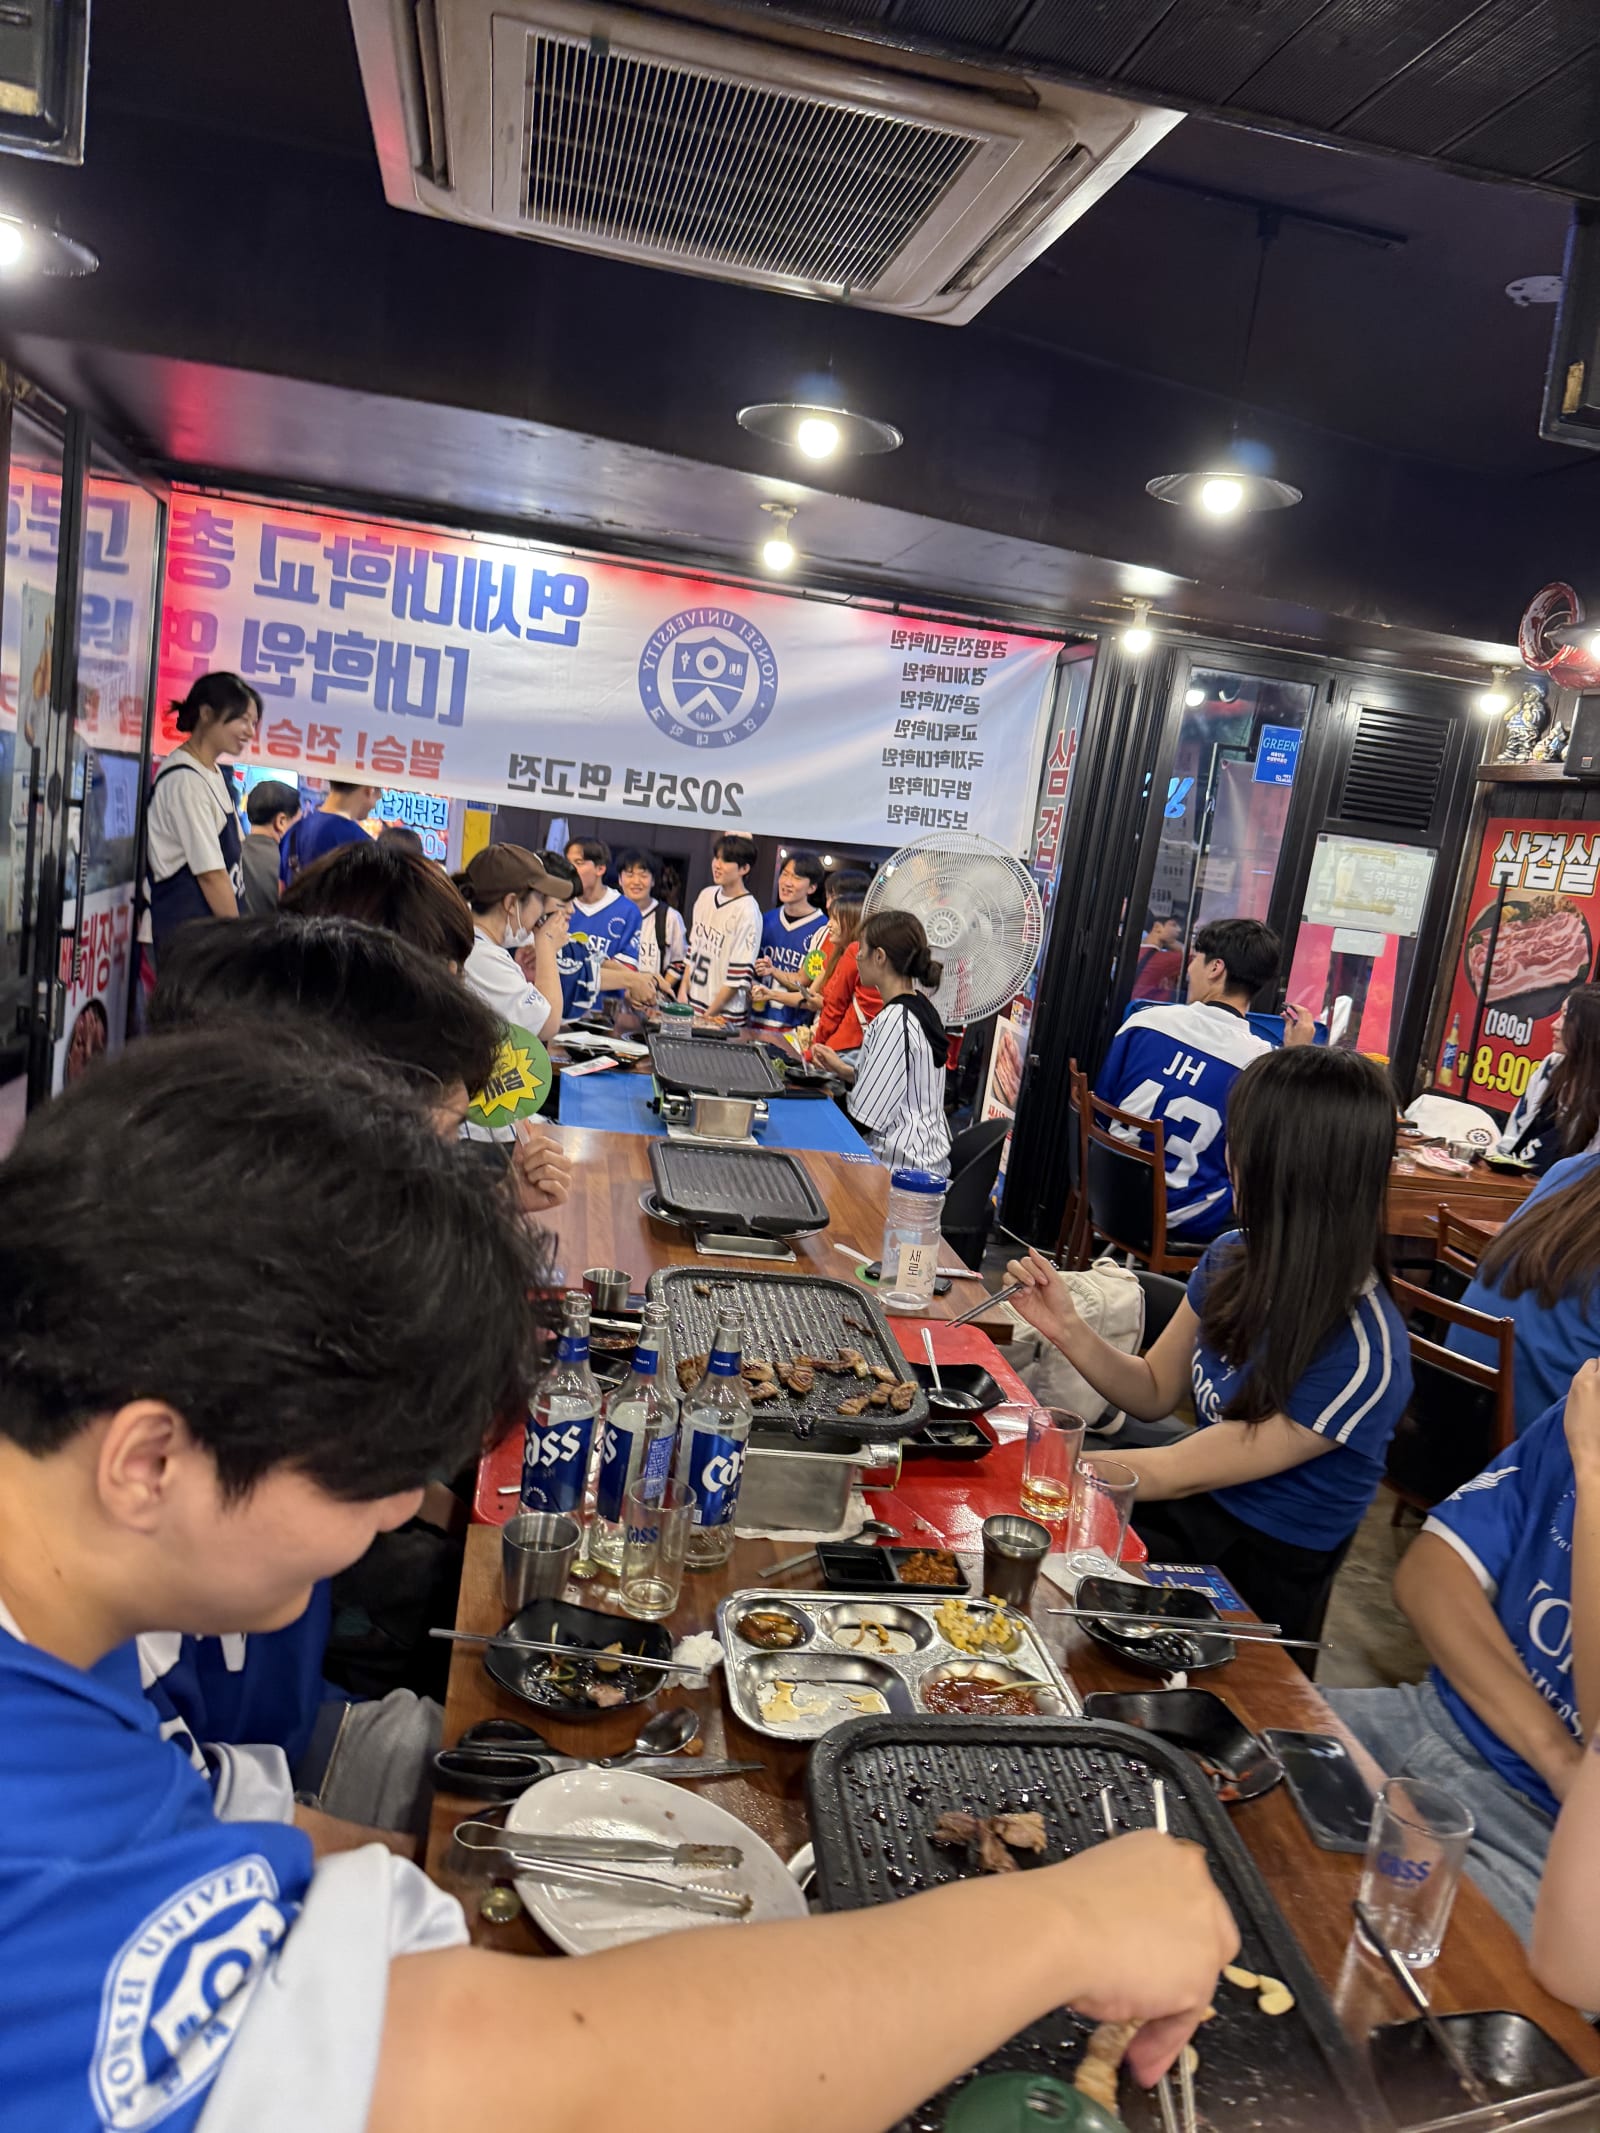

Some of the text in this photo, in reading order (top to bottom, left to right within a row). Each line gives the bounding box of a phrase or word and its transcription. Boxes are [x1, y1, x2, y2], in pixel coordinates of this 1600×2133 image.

[1262, 737, 1298, 752] GREEN
[374, 790, 447, 825] 날개튀김
[1488, 830, 1600, 897] 삼겹살
[1484, 1008, 1534, 1046] (180g)
[1162, 1051, 1206, 1087] JH
[1108, 1078, 1223, 1190] 43
[525, 1425, 582, 1468] ass
